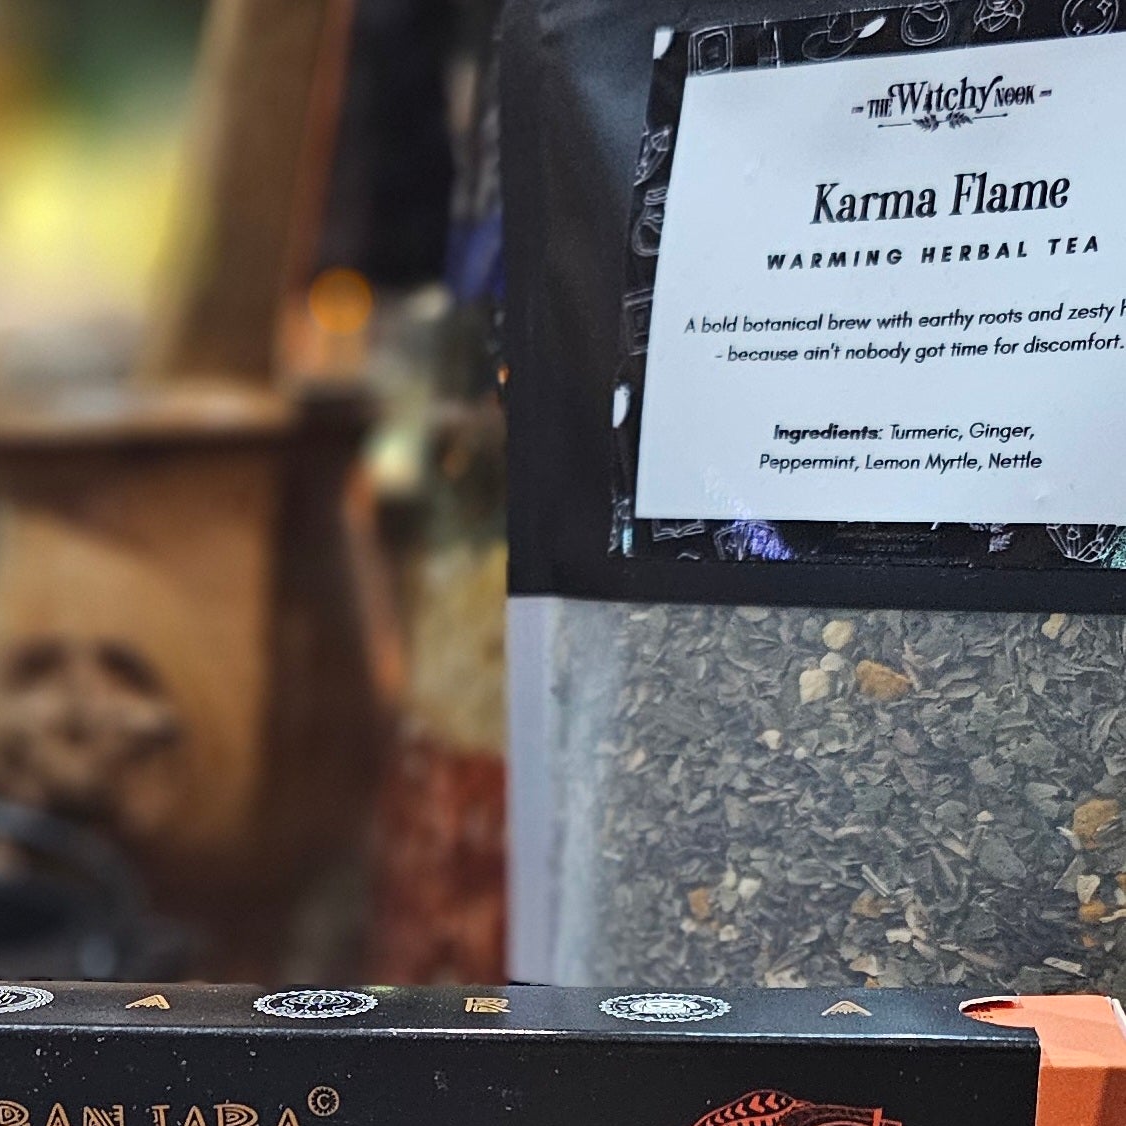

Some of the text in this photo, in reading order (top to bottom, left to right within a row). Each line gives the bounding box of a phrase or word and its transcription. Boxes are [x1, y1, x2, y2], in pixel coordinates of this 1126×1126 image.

[867, 75, 1035, 119] THE Witchy NOOK
[809, 171, 1071, 225] Karma Flame
[766, 235, 1099, 271] WARMING HERBAL TEA
[684, 317, 697, 334] A
[701, 316, 738, 334] bold
[742, 313, 824, 333] botanical
[827, 313, 872, 331] brew
[877, 310, 913, 329] with
[918, 308, 975, 331] earthy
[978, 307, 1023, 326] roots
[1027, 302, 1064, 322] and
[1067, 302, 1116, 323] zesty
[727, 346, 799, 362] because
[803, 343, 841, 360] ain't
[845, 341, 911, 364] nobody
[914, 343, 946, 363] got
[950, 341, 989, 357] time
[993, 336, 1020, 355] for
[1023, 332, 1125, 354] discomfort.
[773, 422, 1035, 444] Ingredients: Turmeric, Ginger,
[759, 451, 1043, 474] Peppermint, Lemon Myrtle, Nettle
